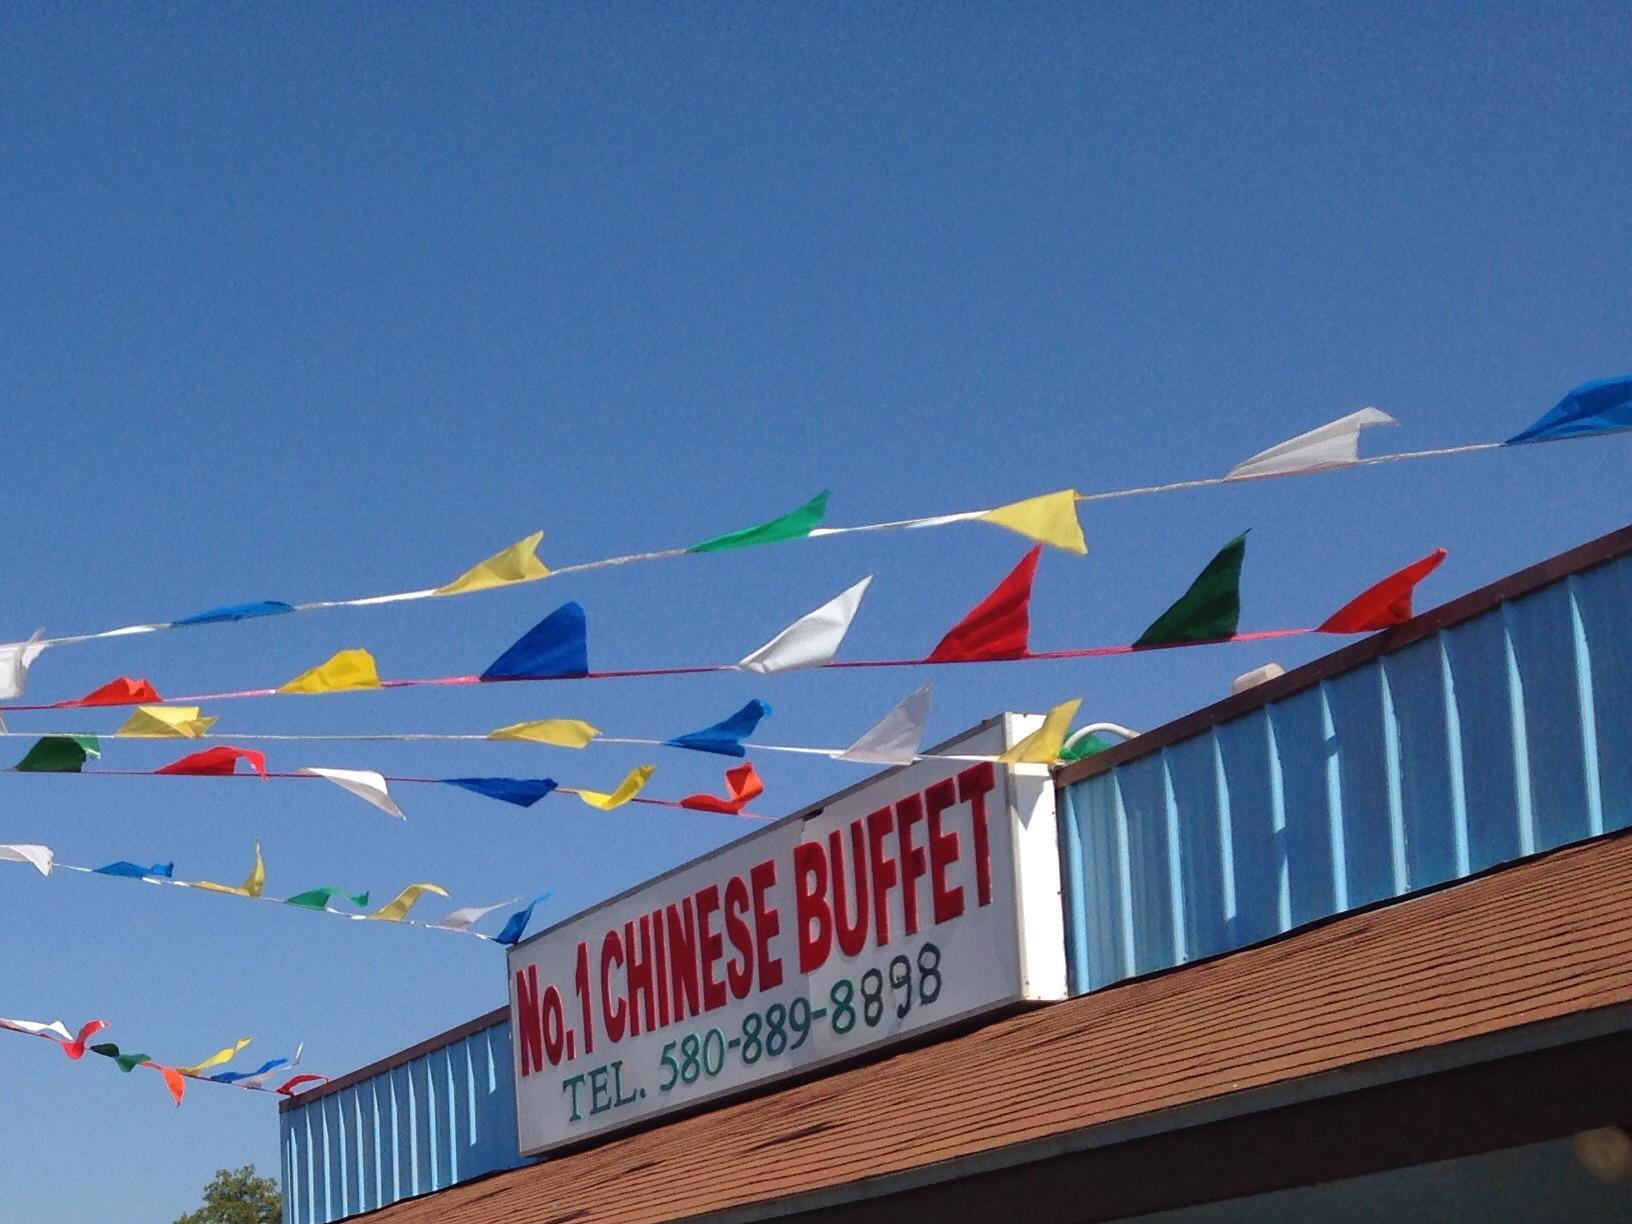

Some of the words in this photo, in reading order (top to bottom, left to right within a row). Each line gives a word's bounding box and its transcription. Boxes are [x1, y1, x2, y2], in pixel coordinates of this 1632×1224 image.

[600, 859, 784, 1045] CHINESE
[793, 761, 996, 976] BUFFET
[562, 1053, 647, 1122] TEL.
[660, 942, 943, 1092] 580-889-8898
